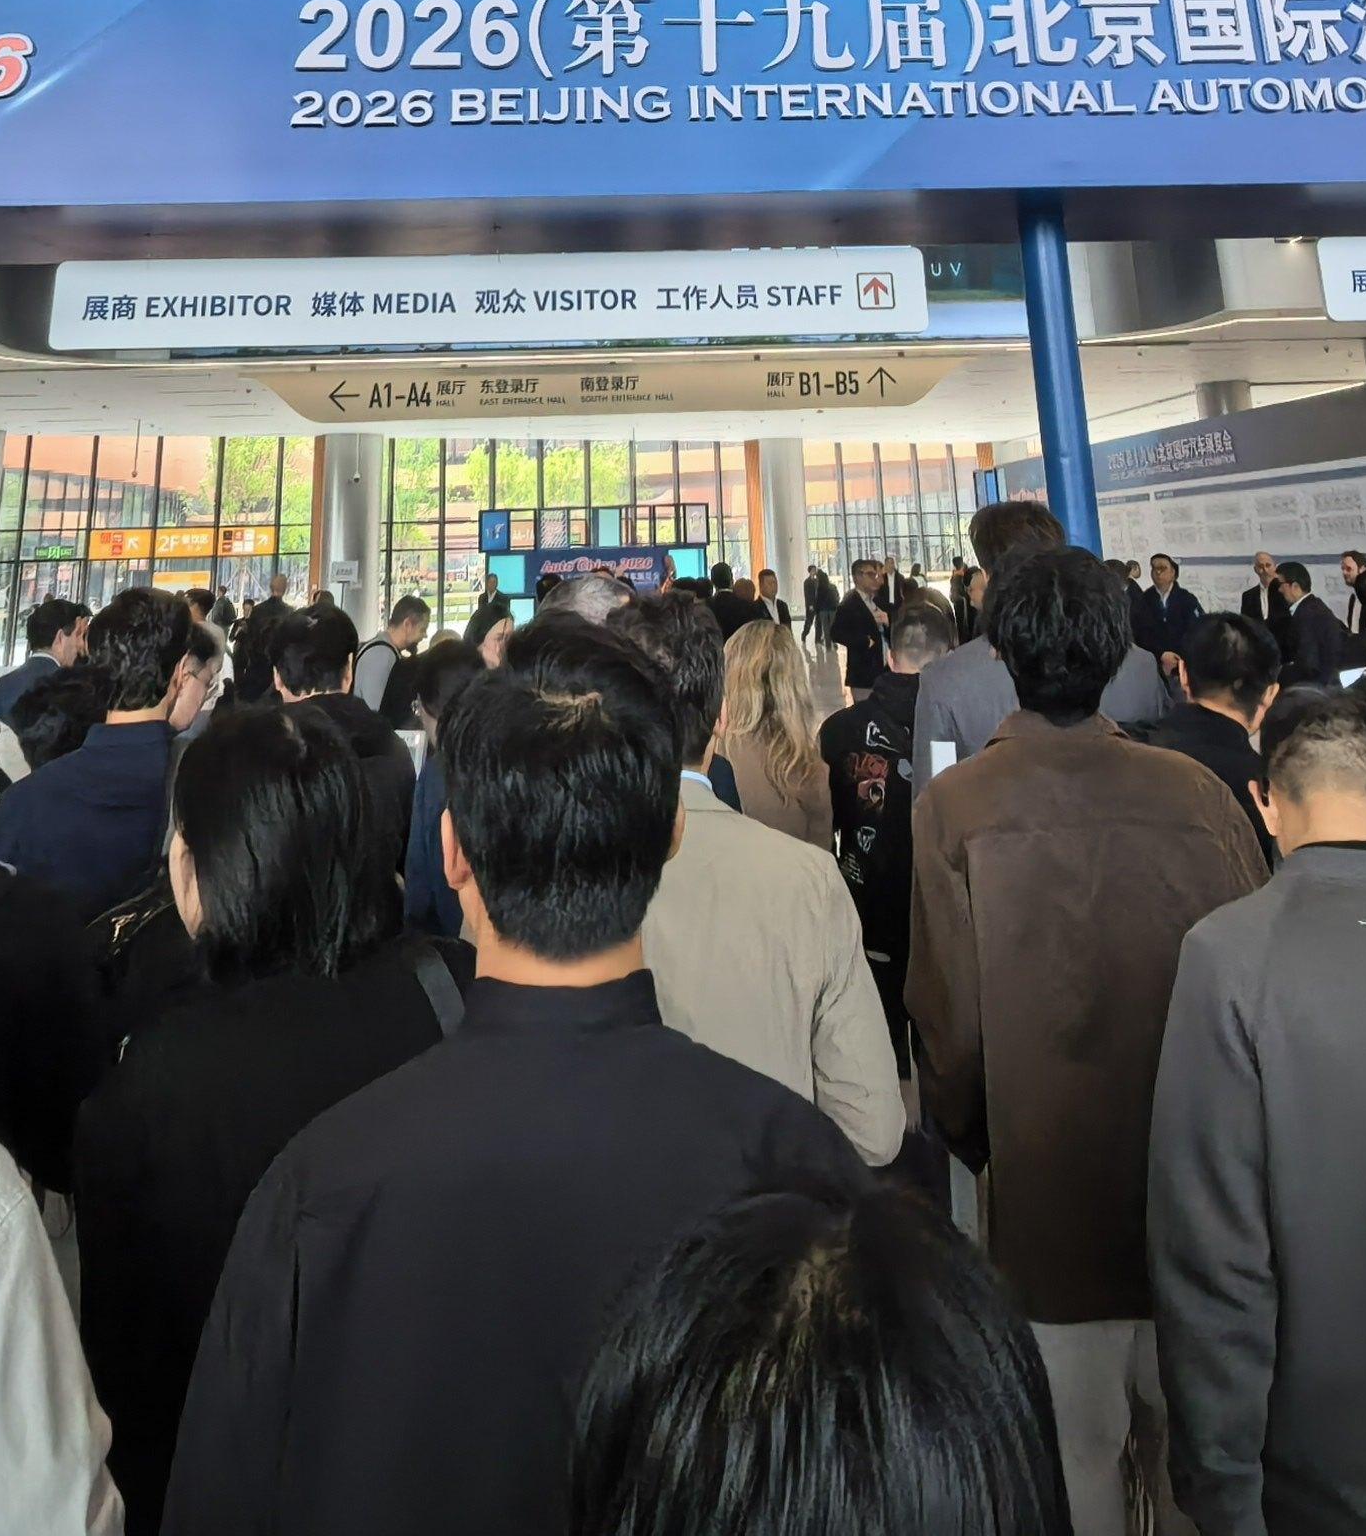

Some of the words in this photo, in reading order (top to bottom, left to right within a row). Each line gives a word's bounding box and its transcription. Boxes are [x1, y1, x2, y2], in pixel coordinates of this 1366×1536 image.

[290, 88, 436, 130] 2026
[449, 83, 673, 126] BEIJING
[687, 76, 1138, 124] INTERNATIONAL
[81, 294, 137, 322] 展商
[144, 293, 292, 319] EXHIBITOR
[310, 289, 365, 317] 媒体
[371, 290, 457, 315] MEDIA
[473, 287, 527, 315] 观众
[533, 287, 638, 314] VISITOR
[655, 283, 759, 311] 工作人员
[765, 283, 843, 307] STAFF
[368, 379, 433, 410] A1-A4
[436, 379, 467, 396] 展厅
[478, 377, 540, 395] 东登录厅
[579, 375, 641, 392] 南登录厅
[765, 371, 795, 388] 展厅
[798, 368, 861, 398] B1-B5
[157, 534, 180, 553] 2F
